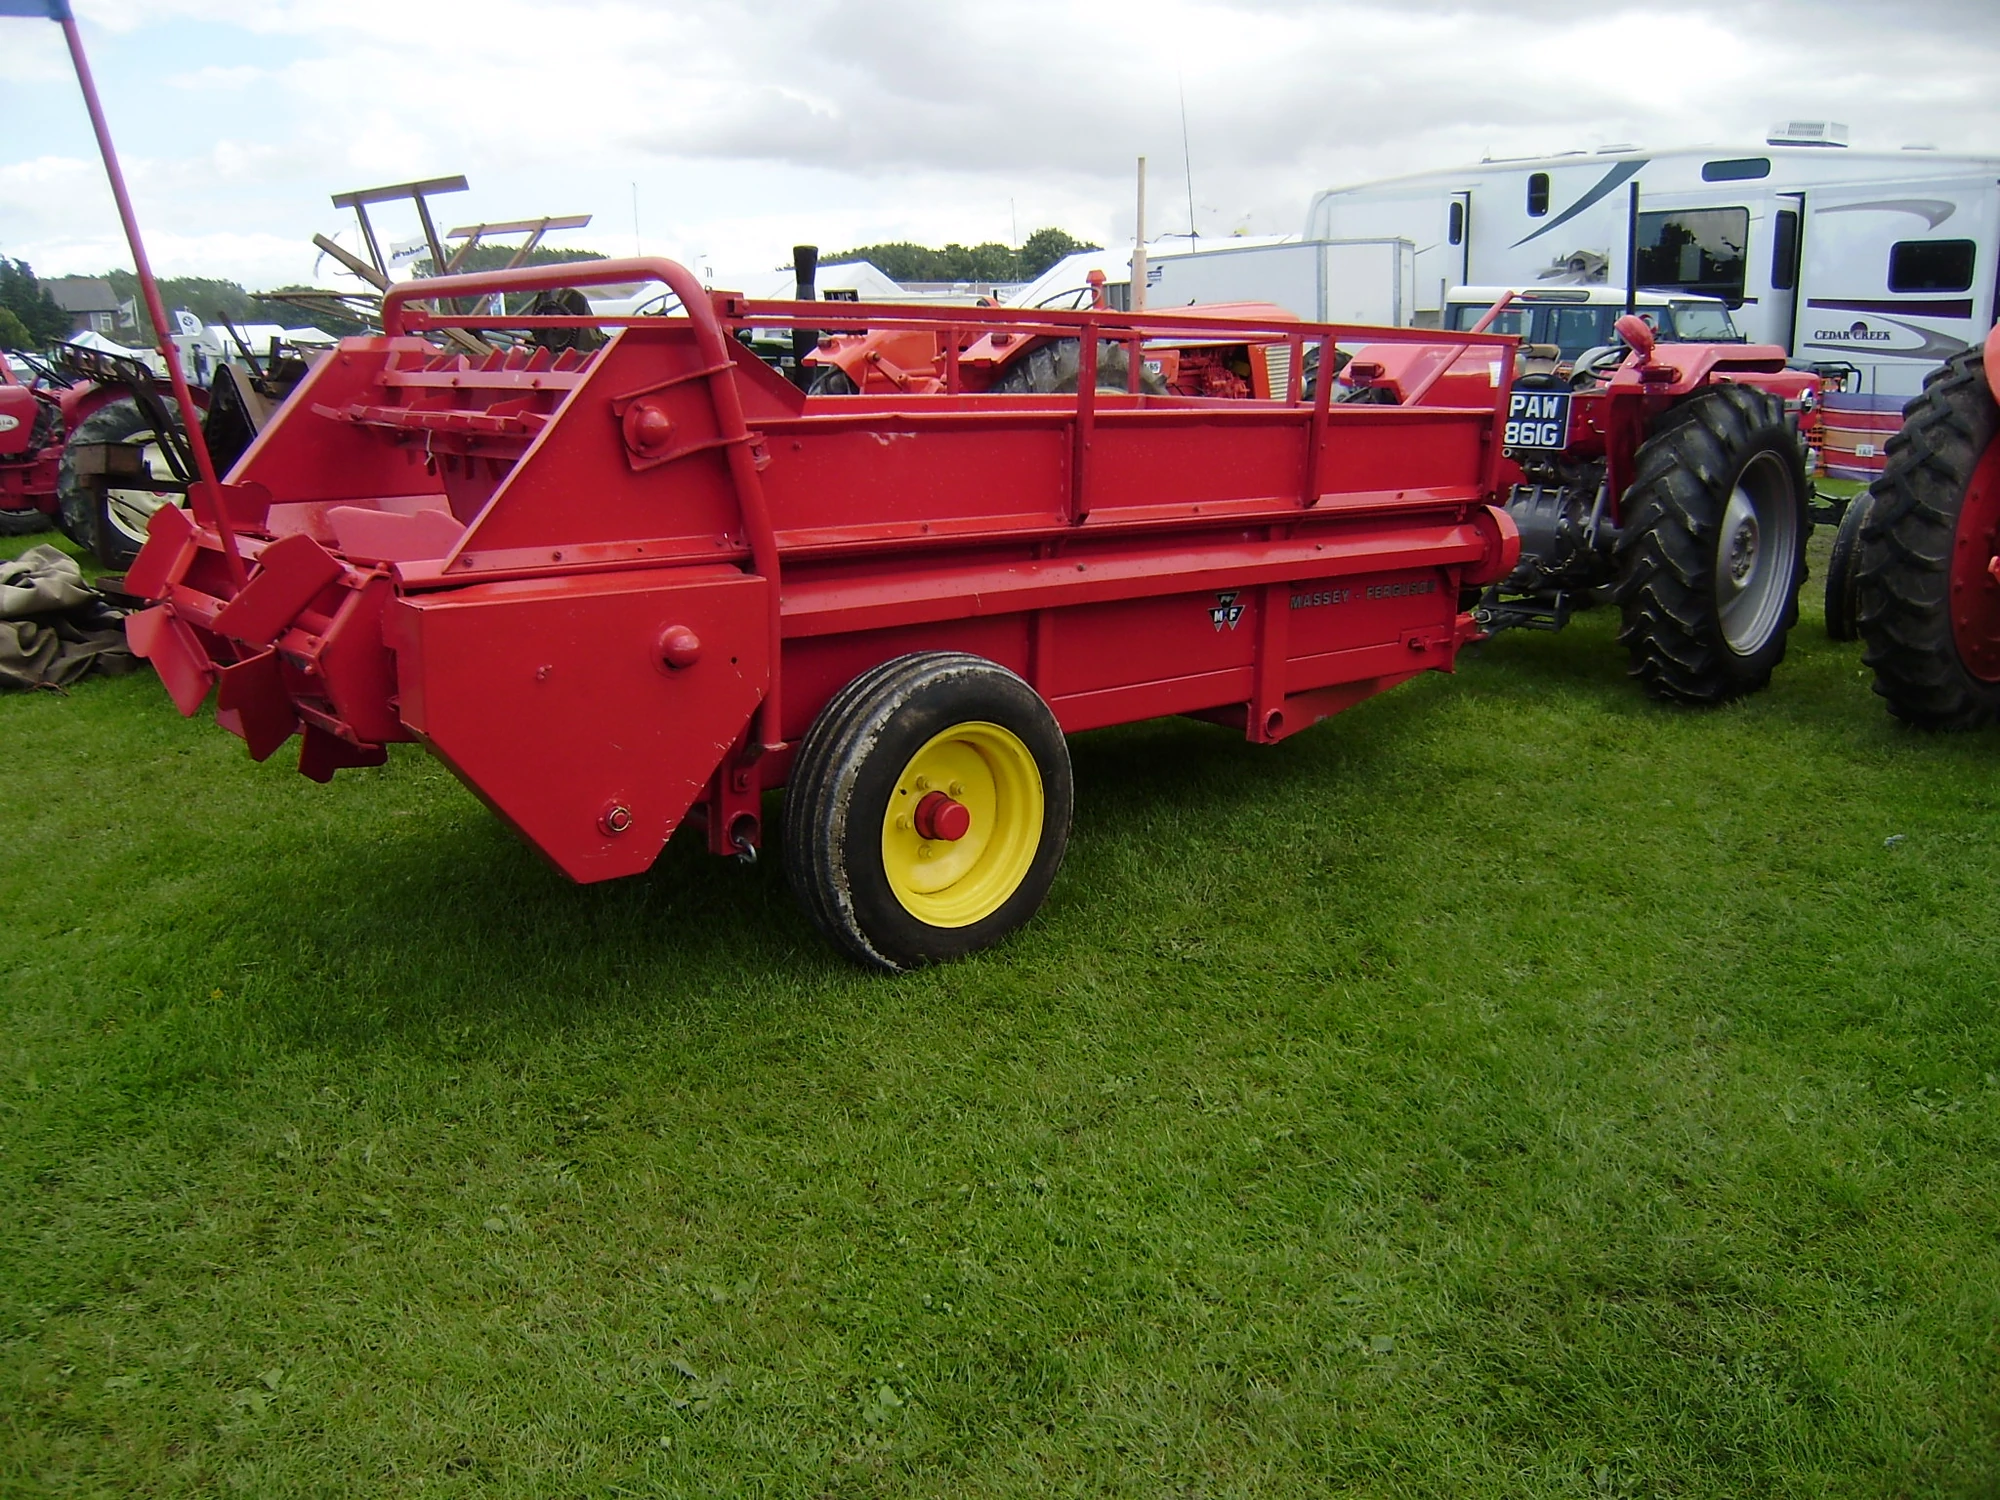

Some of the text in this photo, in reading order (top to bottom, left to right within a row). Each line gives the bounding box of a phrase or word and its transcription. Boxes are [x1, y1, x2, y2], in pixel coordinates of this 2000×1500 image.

[1814, 330, 1891, 341] CEDAR CREEK
[1509, 395, 1559, 419] PAW
[1503, 422, 1558, 446] 861G
[1290, 589, 1350, 610] MASSEY
[1366, 580, 1437, 600] FERGUSON
